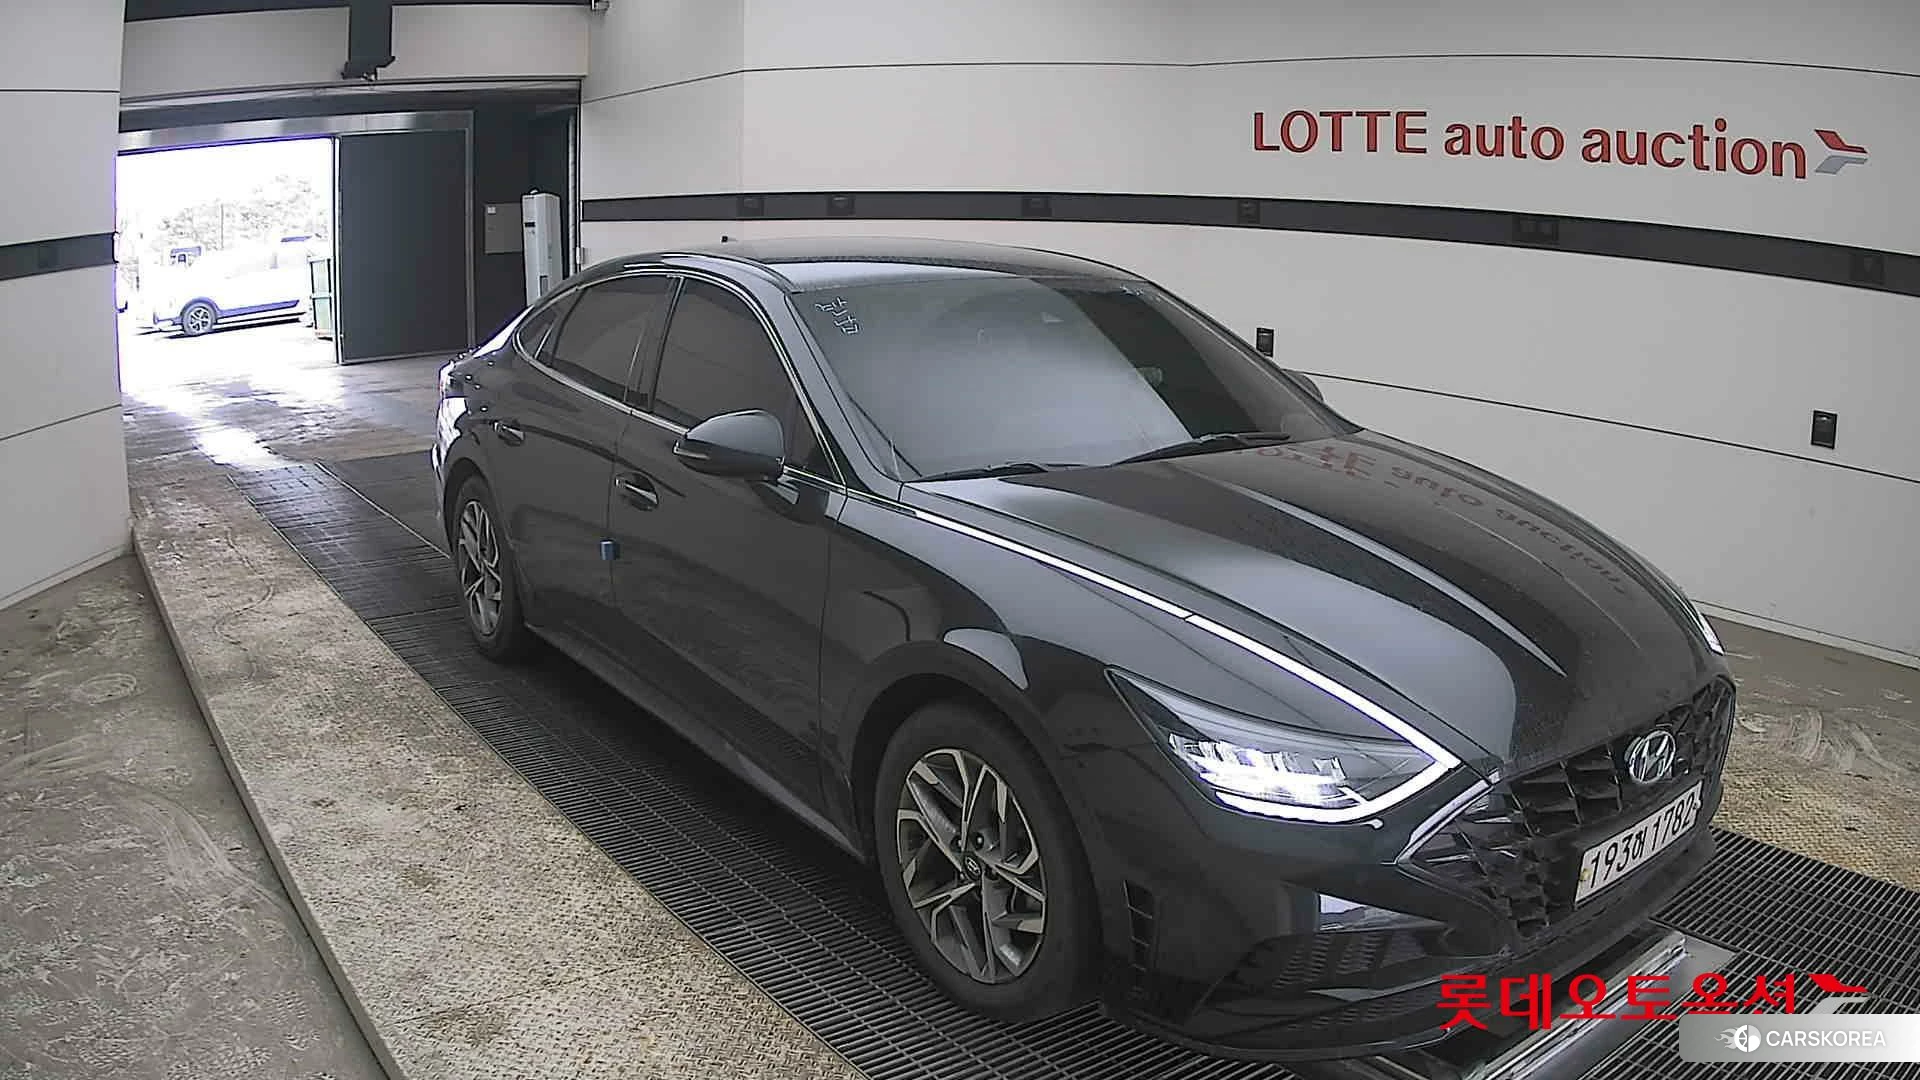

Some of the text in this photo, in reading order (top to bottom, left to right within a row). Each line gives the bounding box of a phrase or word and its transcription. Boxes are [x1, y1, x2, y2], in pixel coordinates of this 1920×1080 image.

[1253, 110, 1807, 180] LOTTE auto auction
[1651, 791, 1696, 851] 1782
